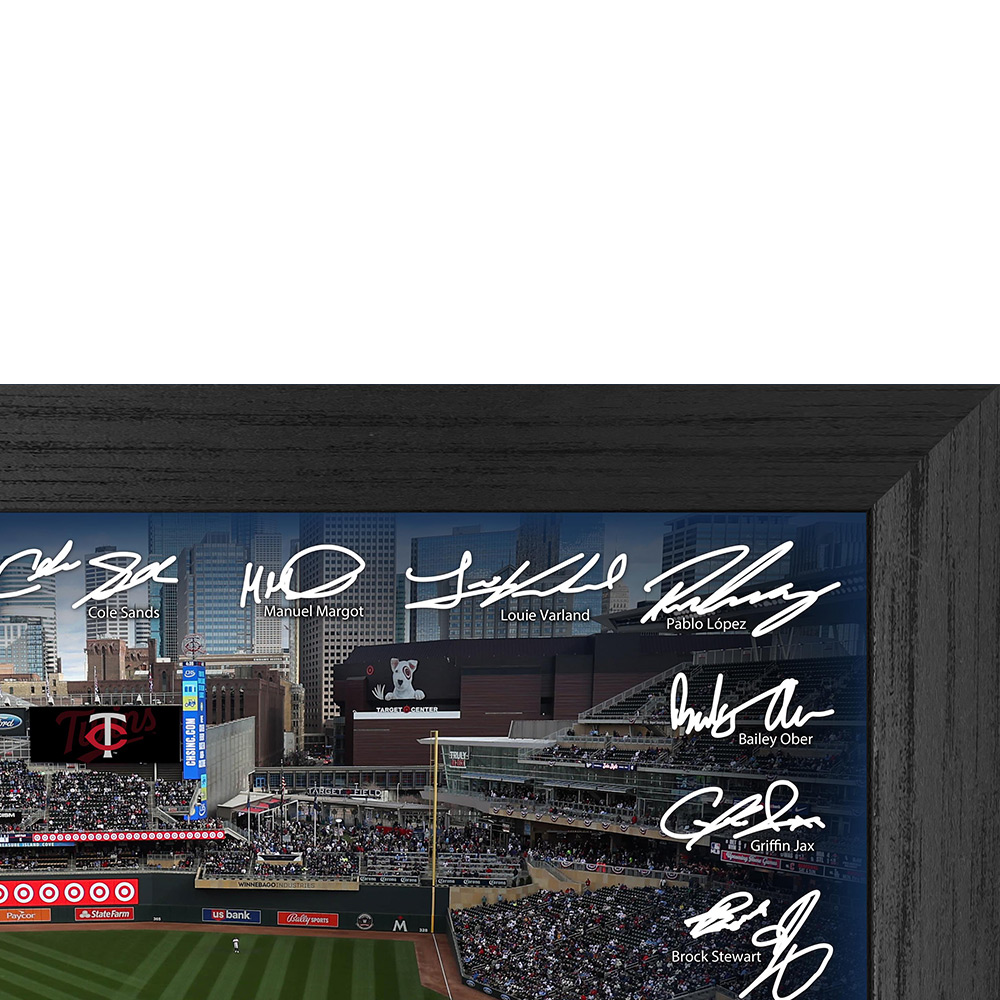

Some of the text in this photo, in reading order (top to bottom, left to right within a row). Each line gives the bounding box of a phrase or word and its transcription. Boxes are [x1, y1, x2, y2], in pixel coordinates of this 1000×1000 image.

[185, 717, 196, 766] CHSINC.COM
[450, 751, 467, 760] TRULY
[308, 788, 342, 796] TARGET
[6, 910, 36, 921] Paycor
[212, 909, 251, 920] us bank
[286, 912, 329, 926] Bally SPORTS
